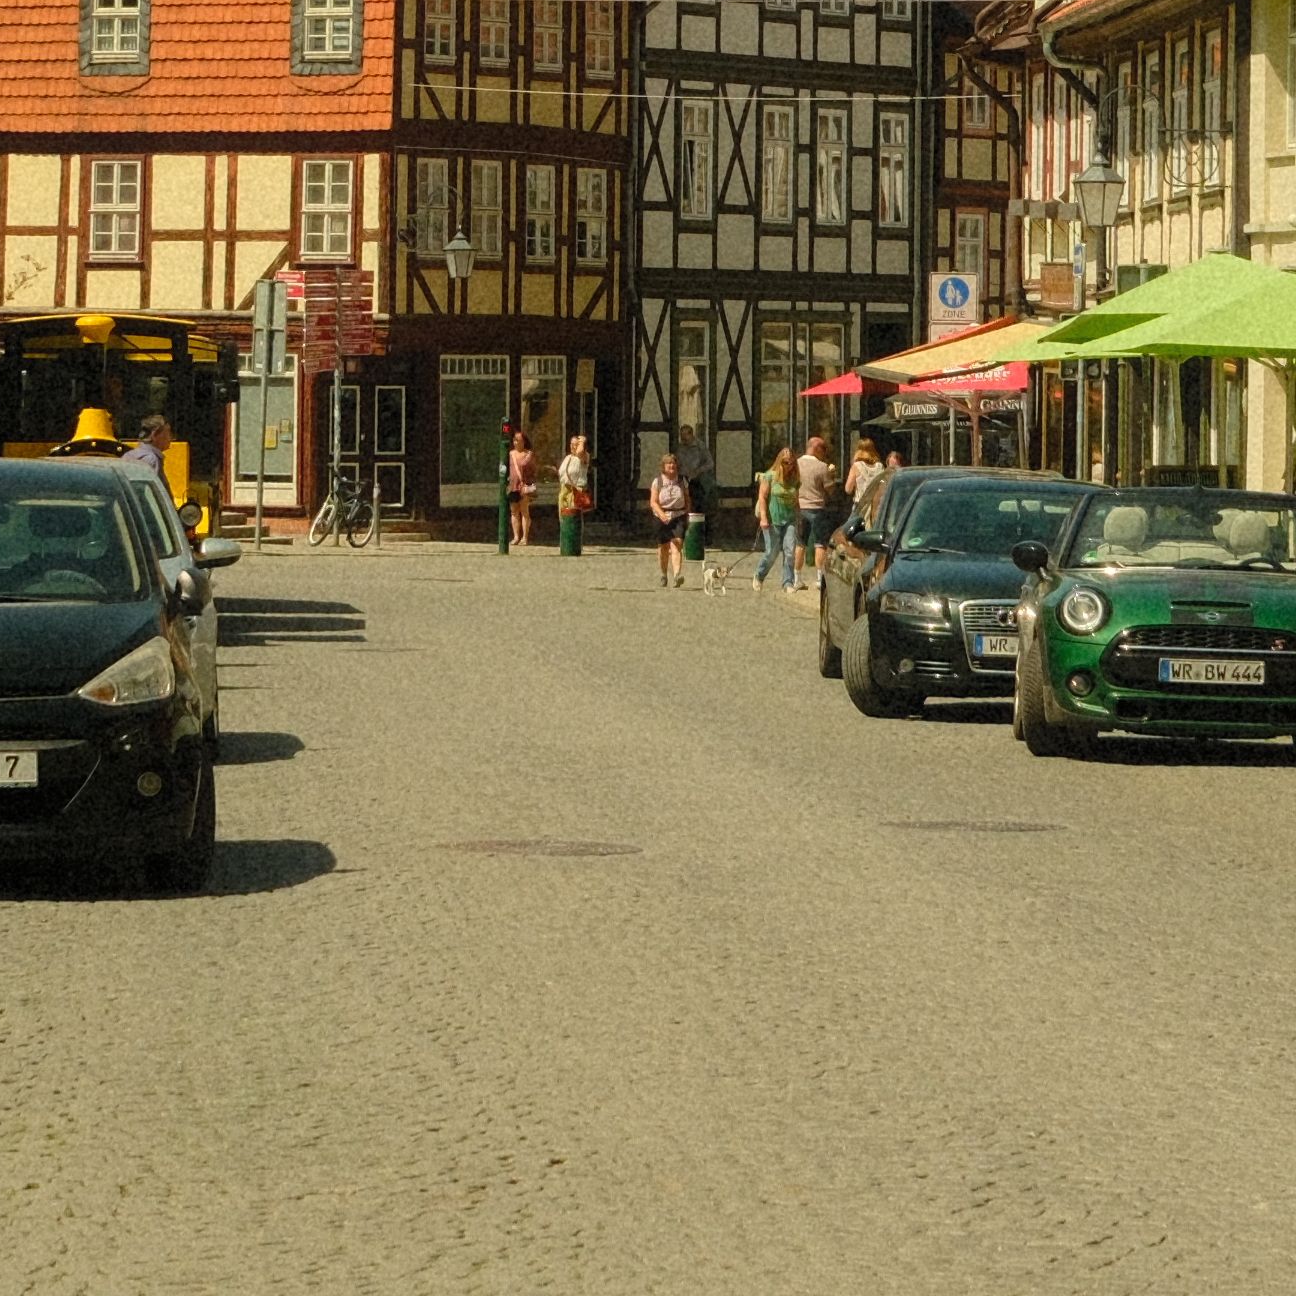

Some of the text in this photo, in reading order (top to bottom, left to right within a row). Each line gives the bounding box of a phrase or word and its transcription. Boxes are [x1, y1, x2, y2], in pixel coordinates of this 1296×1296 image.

[942, 310, 966, 319] ZONE
[902, 403, 938, 415] GUINNESS
[979, 398, 1024, 411] GUINN
[989, 638, 1008, 652] WR
[1171, 663, 1192, 680] WR
